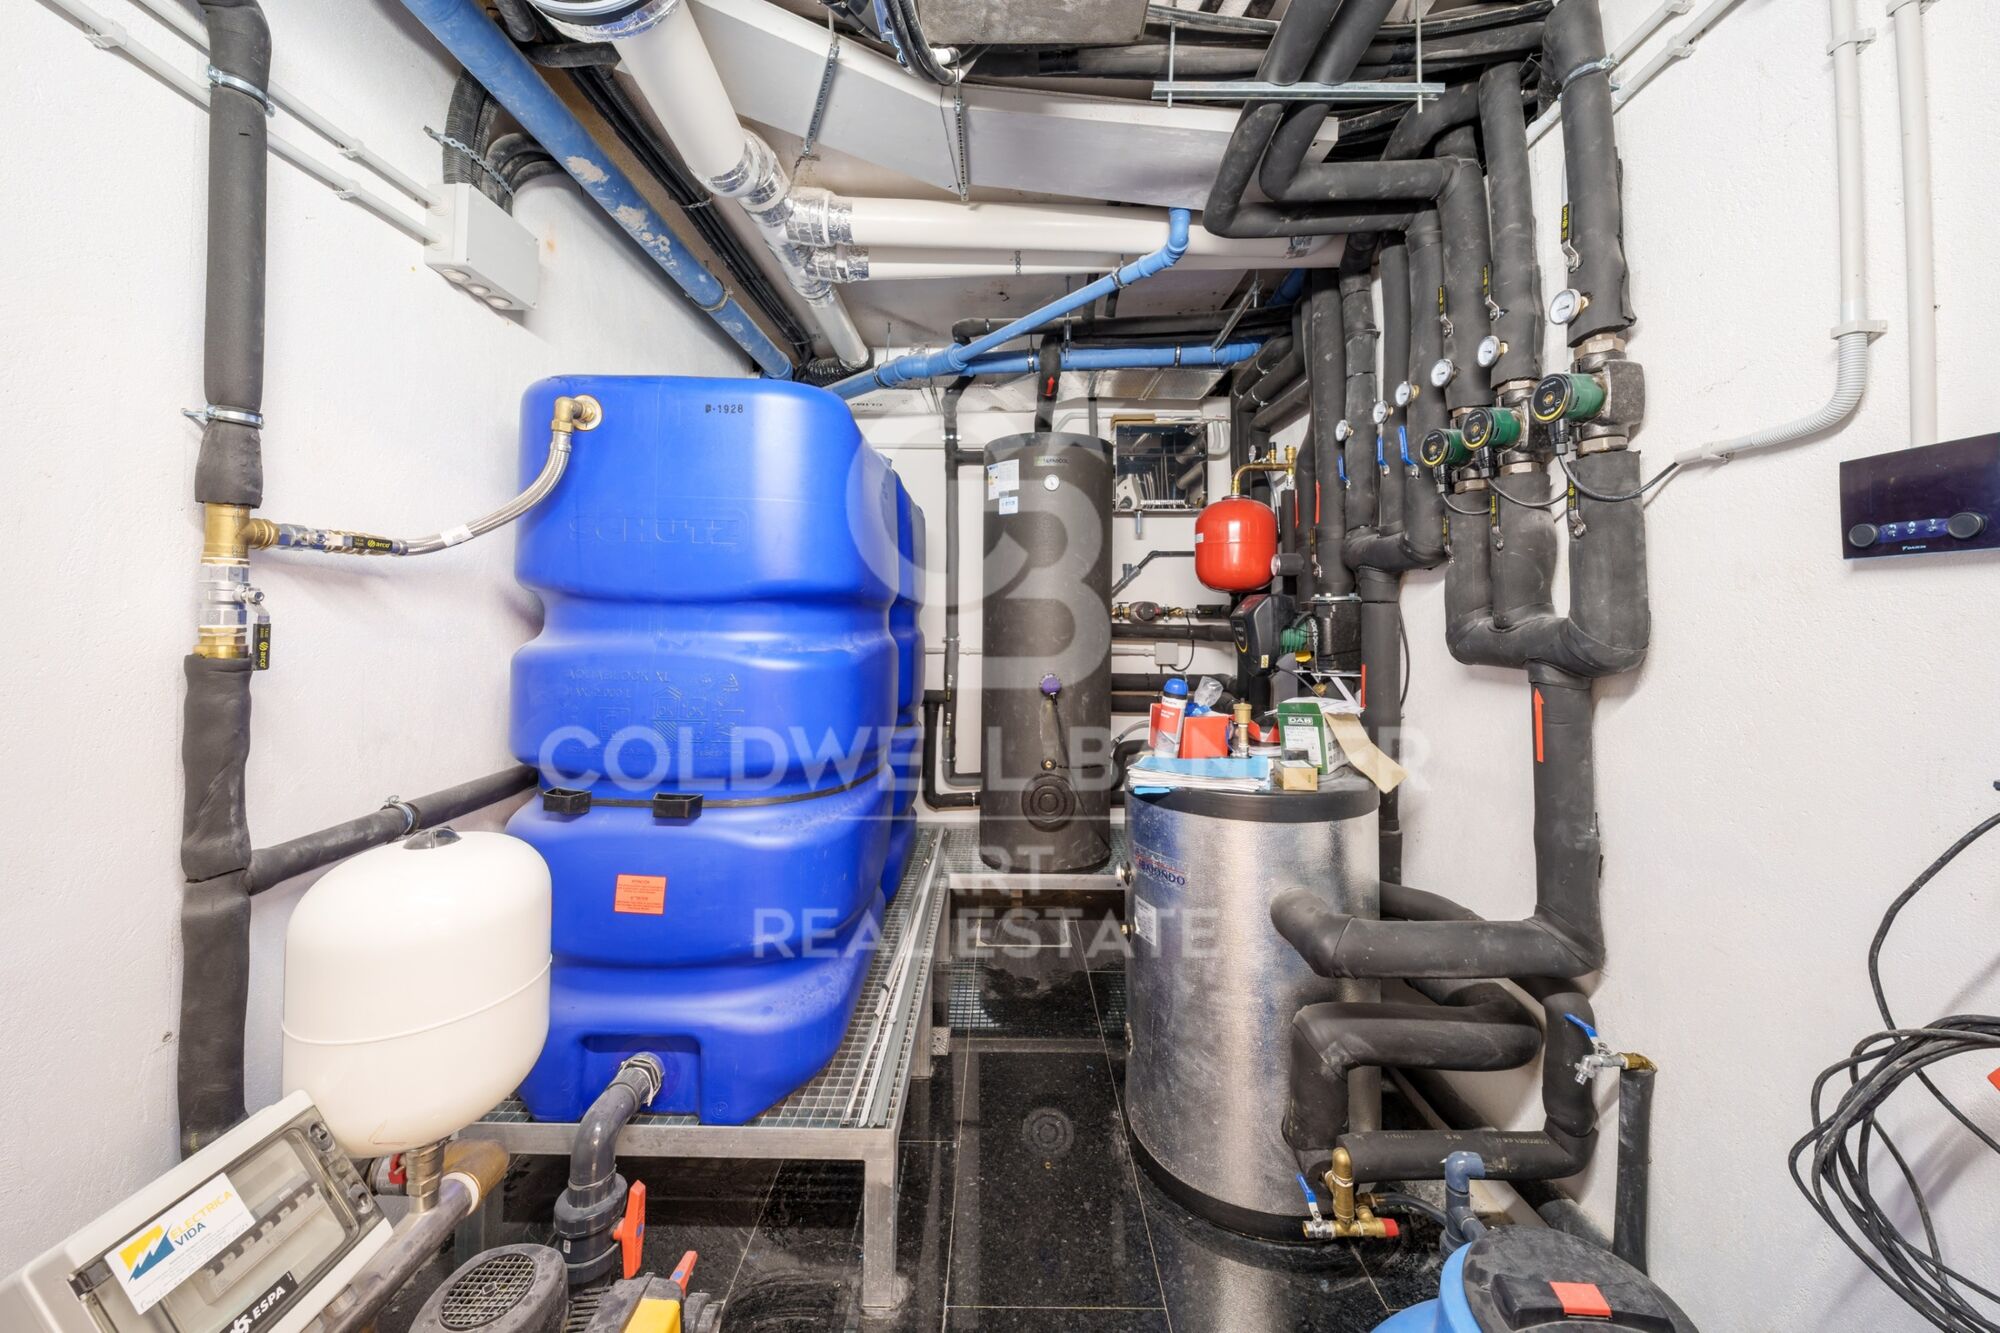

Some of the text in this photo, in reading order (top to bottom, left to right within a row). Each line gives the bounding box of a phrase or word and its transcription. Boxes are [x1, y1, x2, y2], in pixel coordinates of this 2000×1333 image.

[1289, 717, 1312, 725] DAB
[174, 1221, 207, 1247] VIDA
[252, 1286, 286, 1320] ESPA
